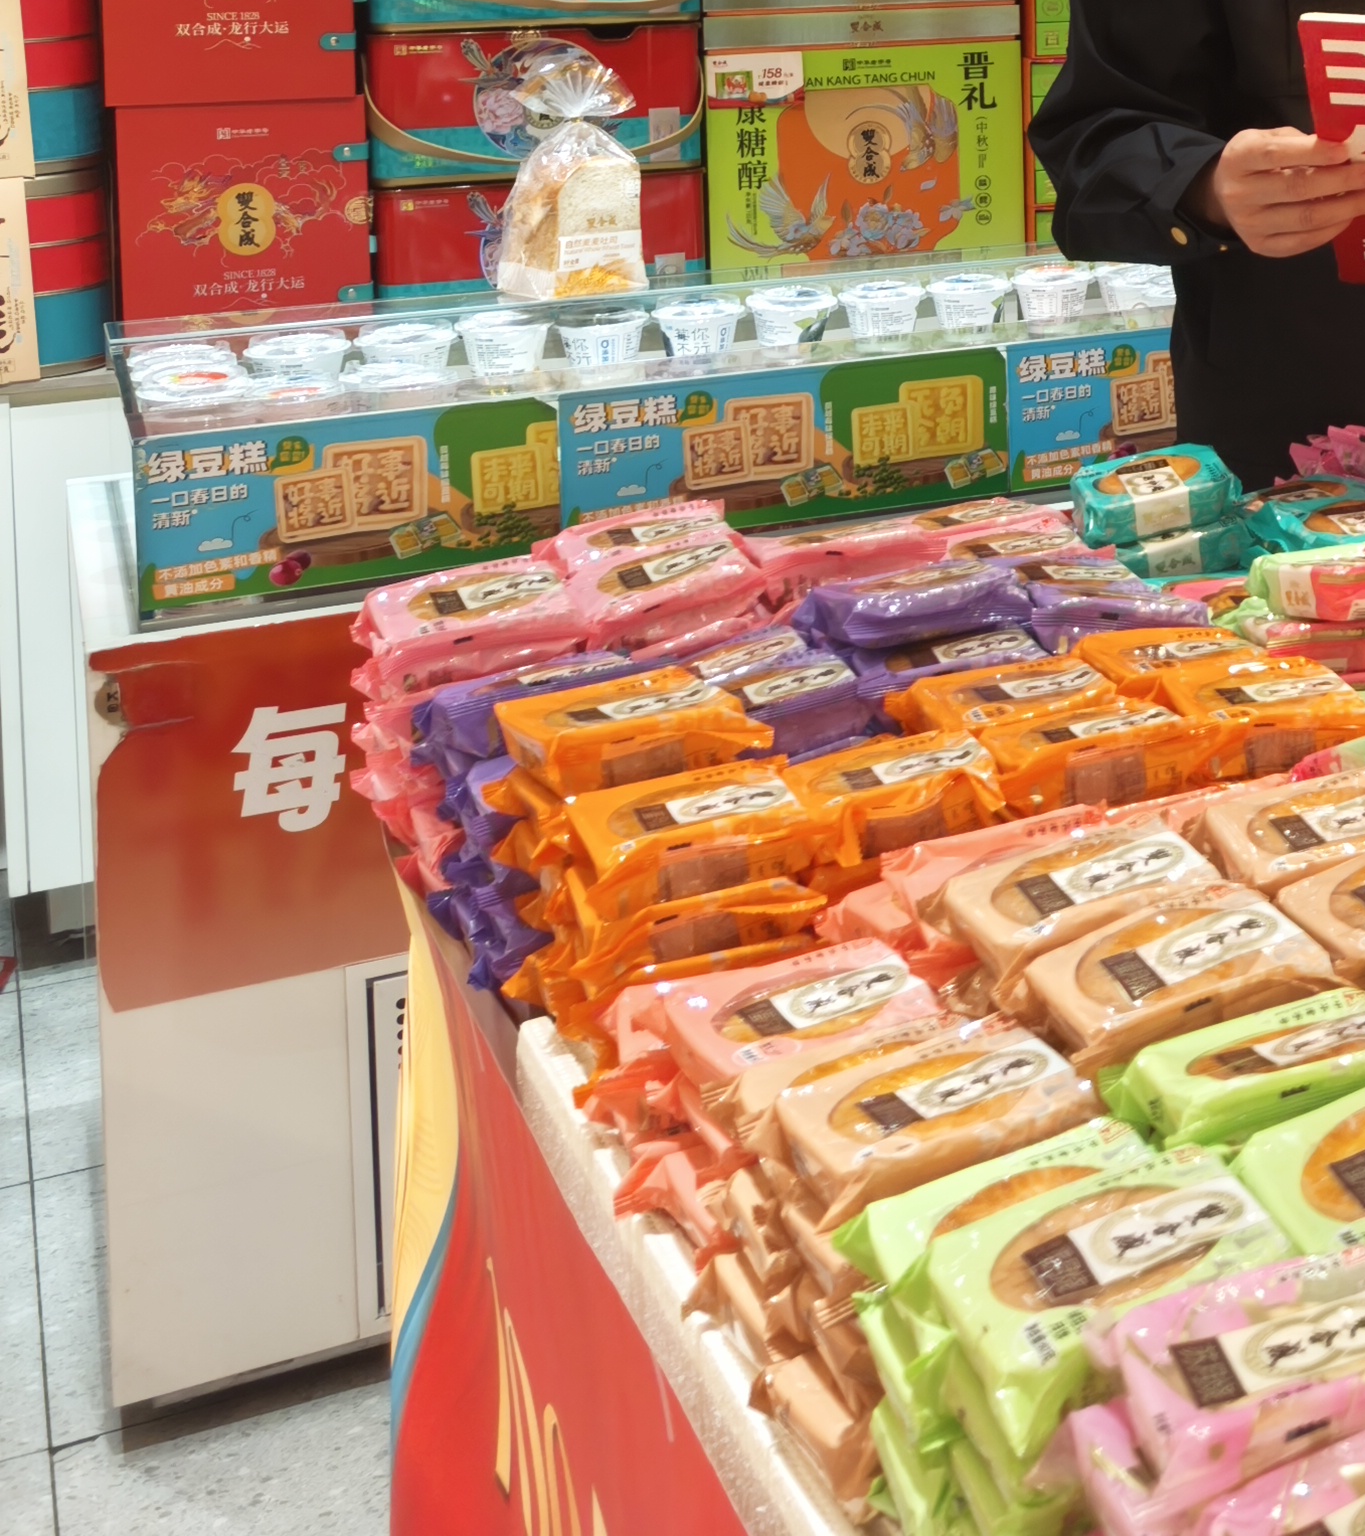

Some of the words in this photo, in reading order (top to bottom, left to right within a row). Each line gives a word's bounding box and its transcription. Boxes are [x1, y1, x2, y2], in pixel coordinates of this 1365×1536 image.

[206, 11, 238, 22] SINCE
[175, 19, 290, 38] 双合成·龙行大运
[761, 67, 783, 79] 158
[826, 74, 861, 87] KANG
[864, 72, 897, 85] TANG
[899, 70, 936, 83] CHUN
[957, 50, 998, 112] 晋礼
[735, 107, 768, 191] 康糖醇
[860, 128, 881, 180] 雙合成
[234, 191, 261, 249] 雙合成
[193, 275, 306, 299] 双合成·龙行大运
[223, 270, 254, 282] SINCE
[1018, 347, 1107, 384] 绿豆糕
[1021, 384, 1092, 404] 一口春日的
[573, 394, 680, 435] 绿豆糕
[1022, 404, 1056, 423] 清新
[576, 434, 661, 456] 一口春日的
[1027, 440, 1114, 466] 不添加色素和香精
[147, 440, 270, 485] 绿豆糕
[577, 456, 618, 477] 清新
[1031, 463, 1075, 479] 黄油成分
[150, 484, 250, 507] 一口春日的
[151, 508, 198, 531] 清新
[157, 549, 279, 581] 不添加色素和香精
[163, 576, 225, 599] 黄油成分
[231, 702, 348, 833] 每
[1110, 1199, 1230, 1258] 雙合成
